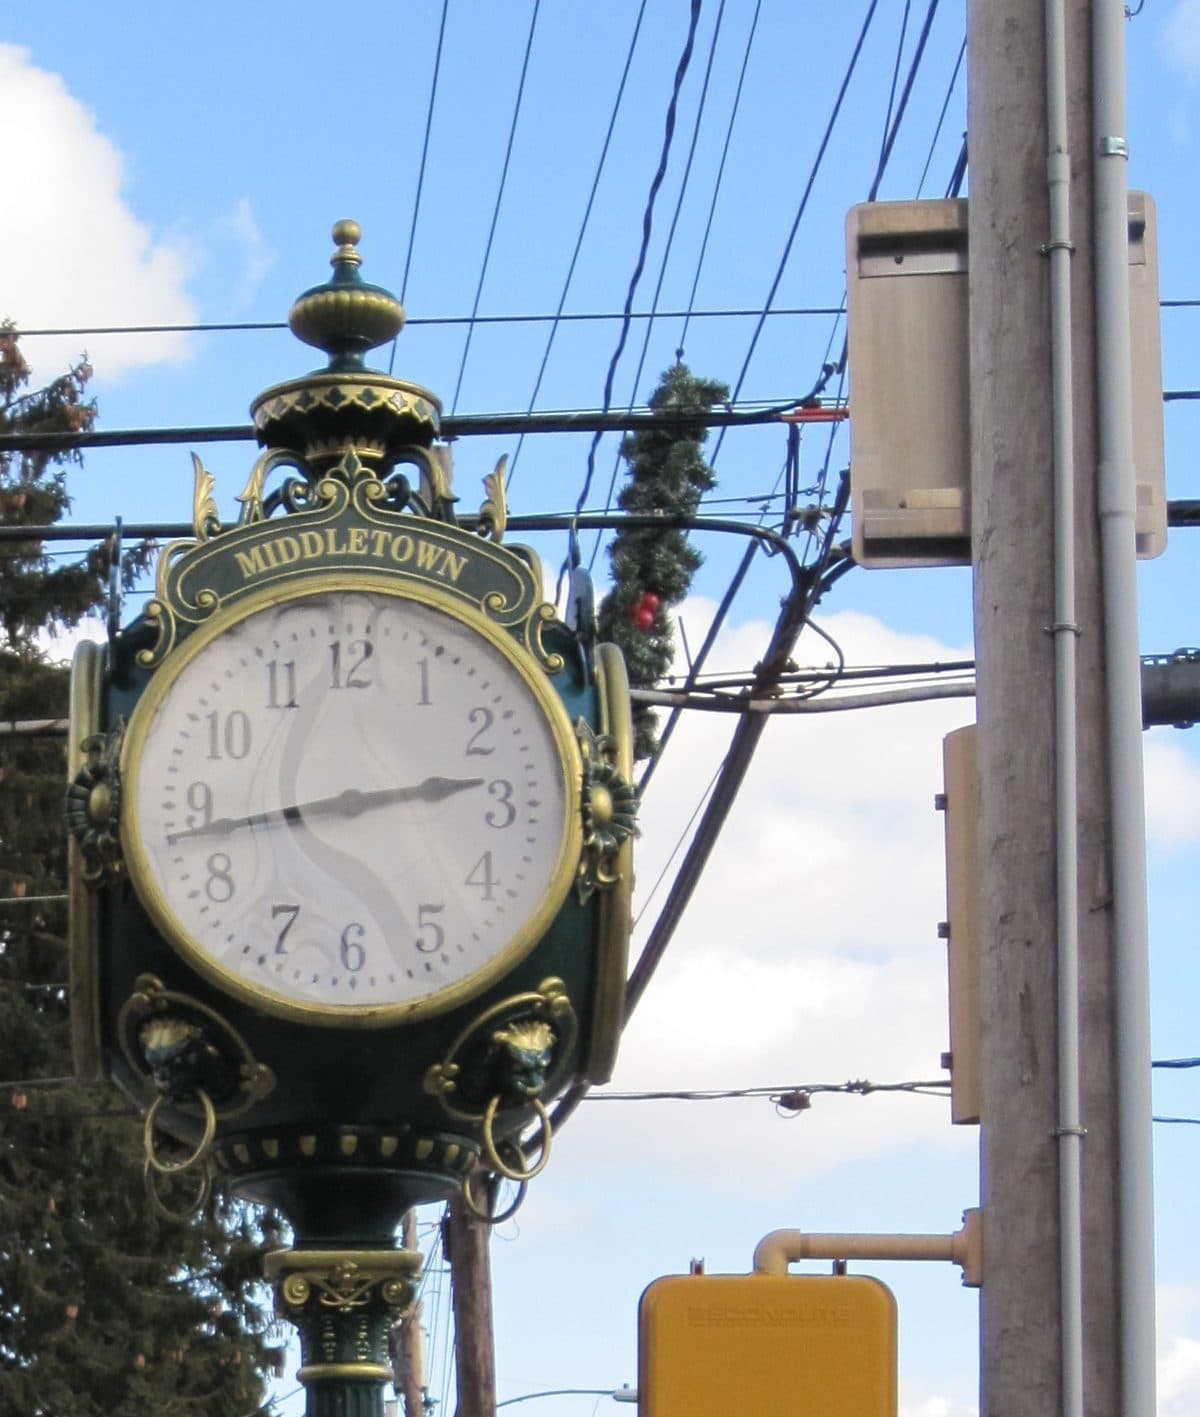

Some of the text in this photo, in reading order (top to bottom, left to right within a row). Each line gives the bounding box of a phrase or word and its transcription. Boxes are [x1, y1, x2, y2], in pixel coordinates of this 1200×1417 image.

[234, 527, 469, 582] MIDDLETOWN
[265, 660, 299, 709] 11
[329, 639, 373, 688] 12
[416, 658, 433, 706] 1
[206, 710, 252, 759] 10
[465, 707, 495, 756] 2
[187, 781, 213, 829] 9
[485, 780, 516, 828] 3
[206, 853, 235, 902] 8
[465, 851, 500, 900] 4
[271, 905, 300, 954] 7
[340, 923, 366, 971] 6
[416, 904, 446, 953] 5
